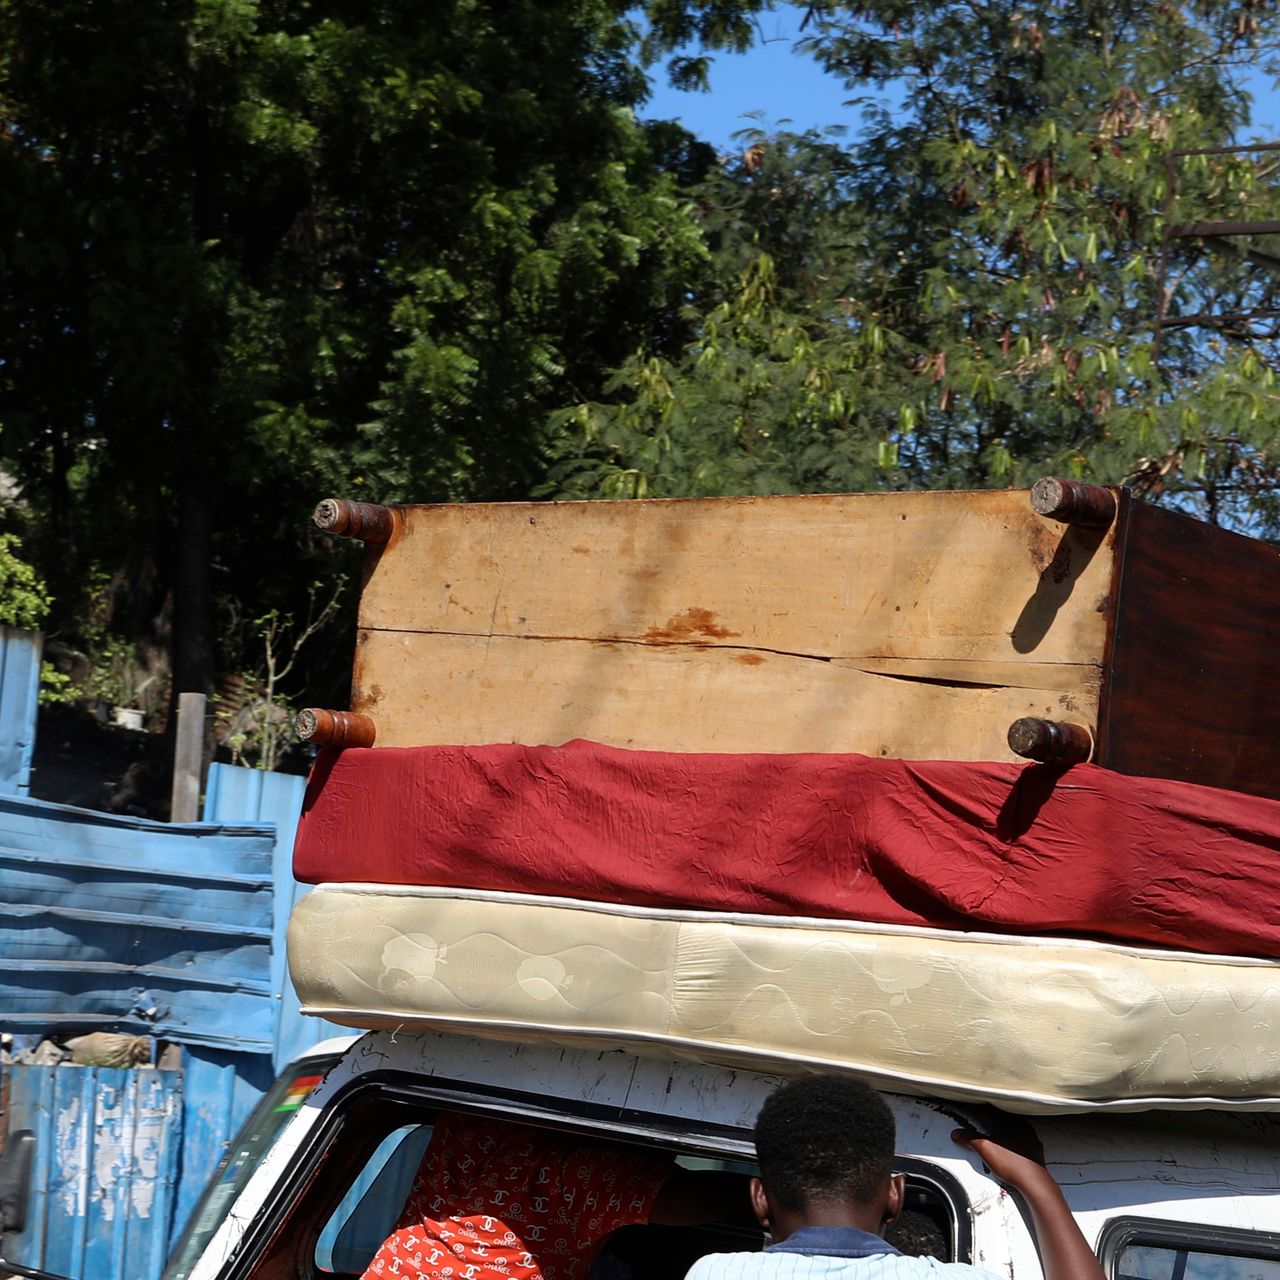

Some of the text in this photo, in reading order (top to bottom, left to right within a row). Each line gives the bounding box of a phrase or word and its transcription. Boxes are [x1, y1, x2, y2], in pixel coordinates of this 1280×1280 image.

[458, 1228, 478, 1240] CHANEL
[493, 1239, 521, 1250] CHANEL
[484, 1262, 511, 1275] CHANEL
